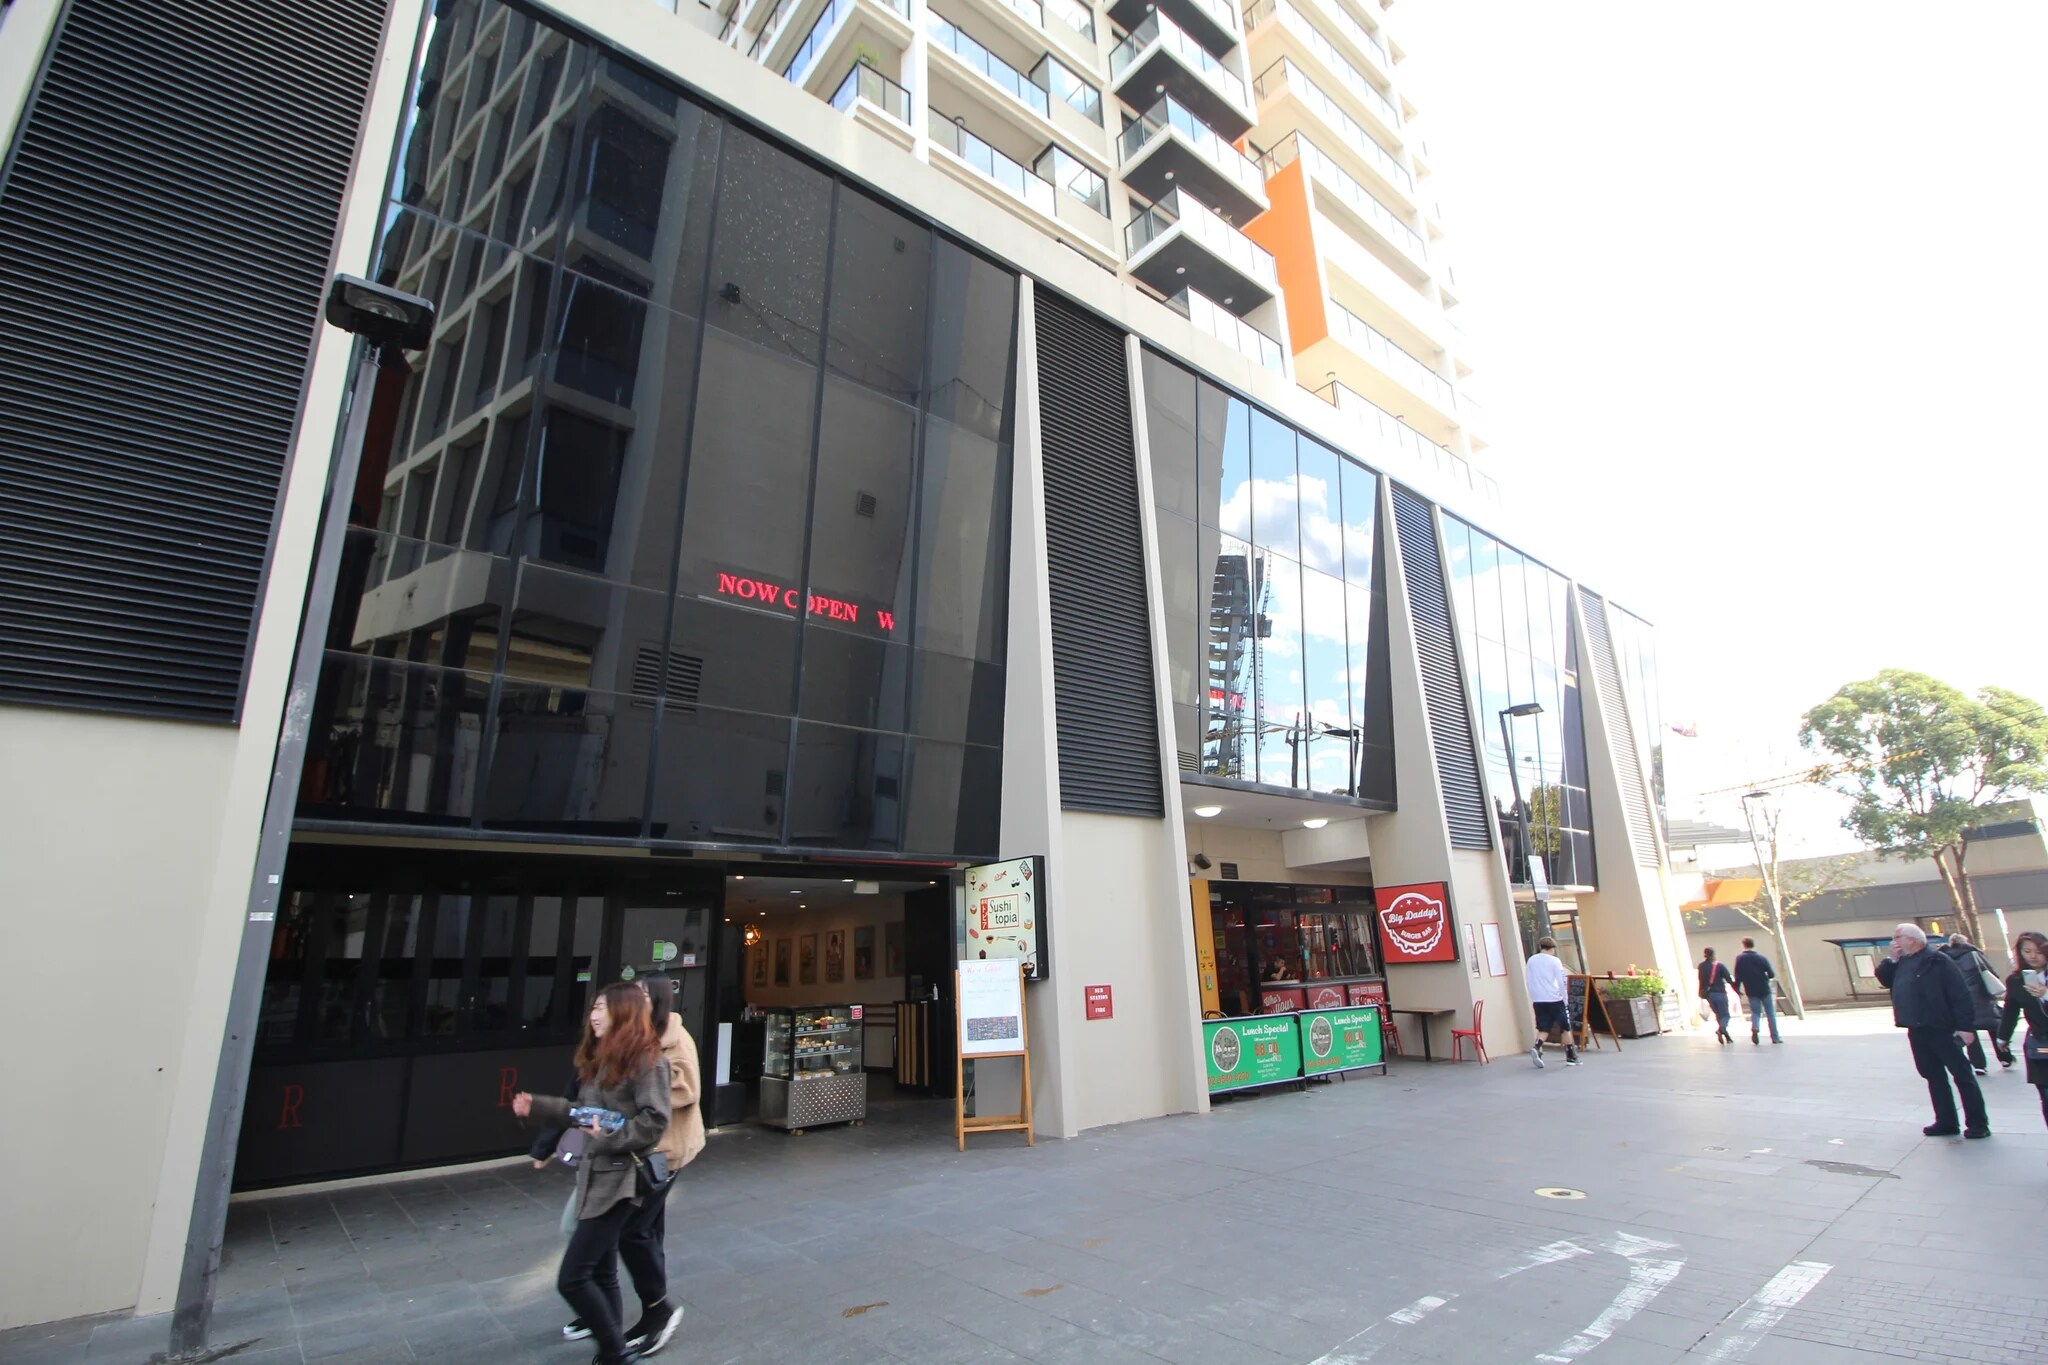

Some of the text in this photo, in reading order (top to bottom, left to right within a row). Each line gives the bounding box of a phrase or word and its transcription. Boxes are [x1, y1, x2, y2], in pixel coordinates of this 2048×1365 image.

[718, 573, 780, 604] NOW
[783, 589, 858, 622] OPEN
[989, 900, 1012, 913] Sushi
[995, 912, 1018, 926] topia
[1388, 913, 1404, 924] Big
[1400, 926, 1432, 939] BURGER BAR
[1334, 1012, 1372, 1025] Lunch Special
[1242, 1022, 1289, 1036] Lunch Special
[278, 1084, 304, 1129] R
